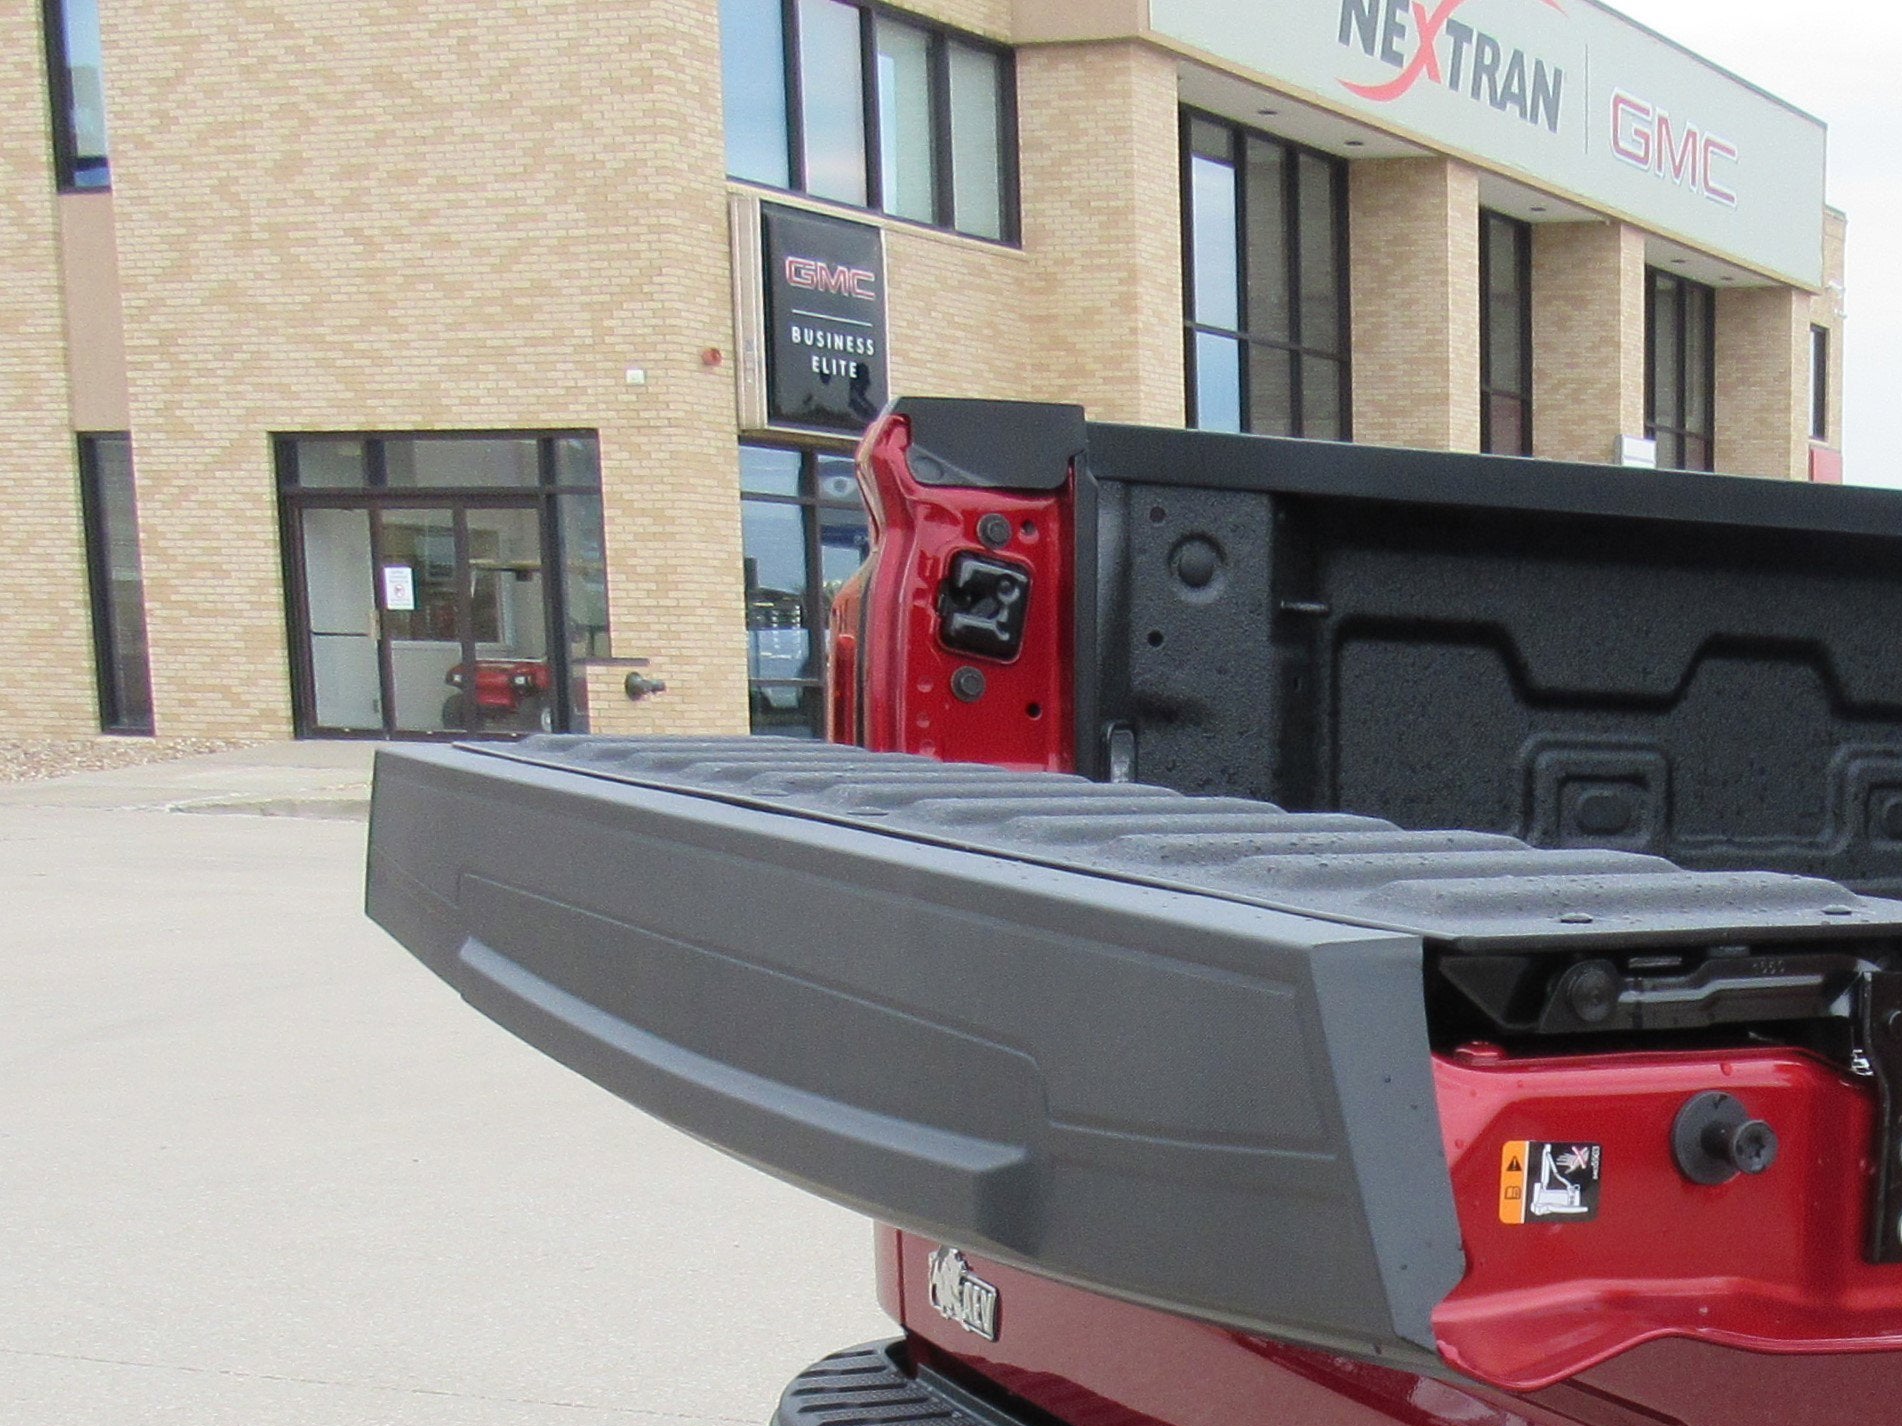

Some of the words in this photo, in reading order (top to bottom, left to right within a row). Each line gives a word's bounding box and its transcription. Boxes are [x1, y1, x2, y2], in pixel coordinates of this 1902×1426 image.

[1337, 0, 1565, 134] NEXTRAN
[1610, 86, 1738, 208] GMC
[785, 256, 876, 300] GMC
[791, 326, 875, 356] BUSINESS
[811, 355, 858, 379] ELITE
